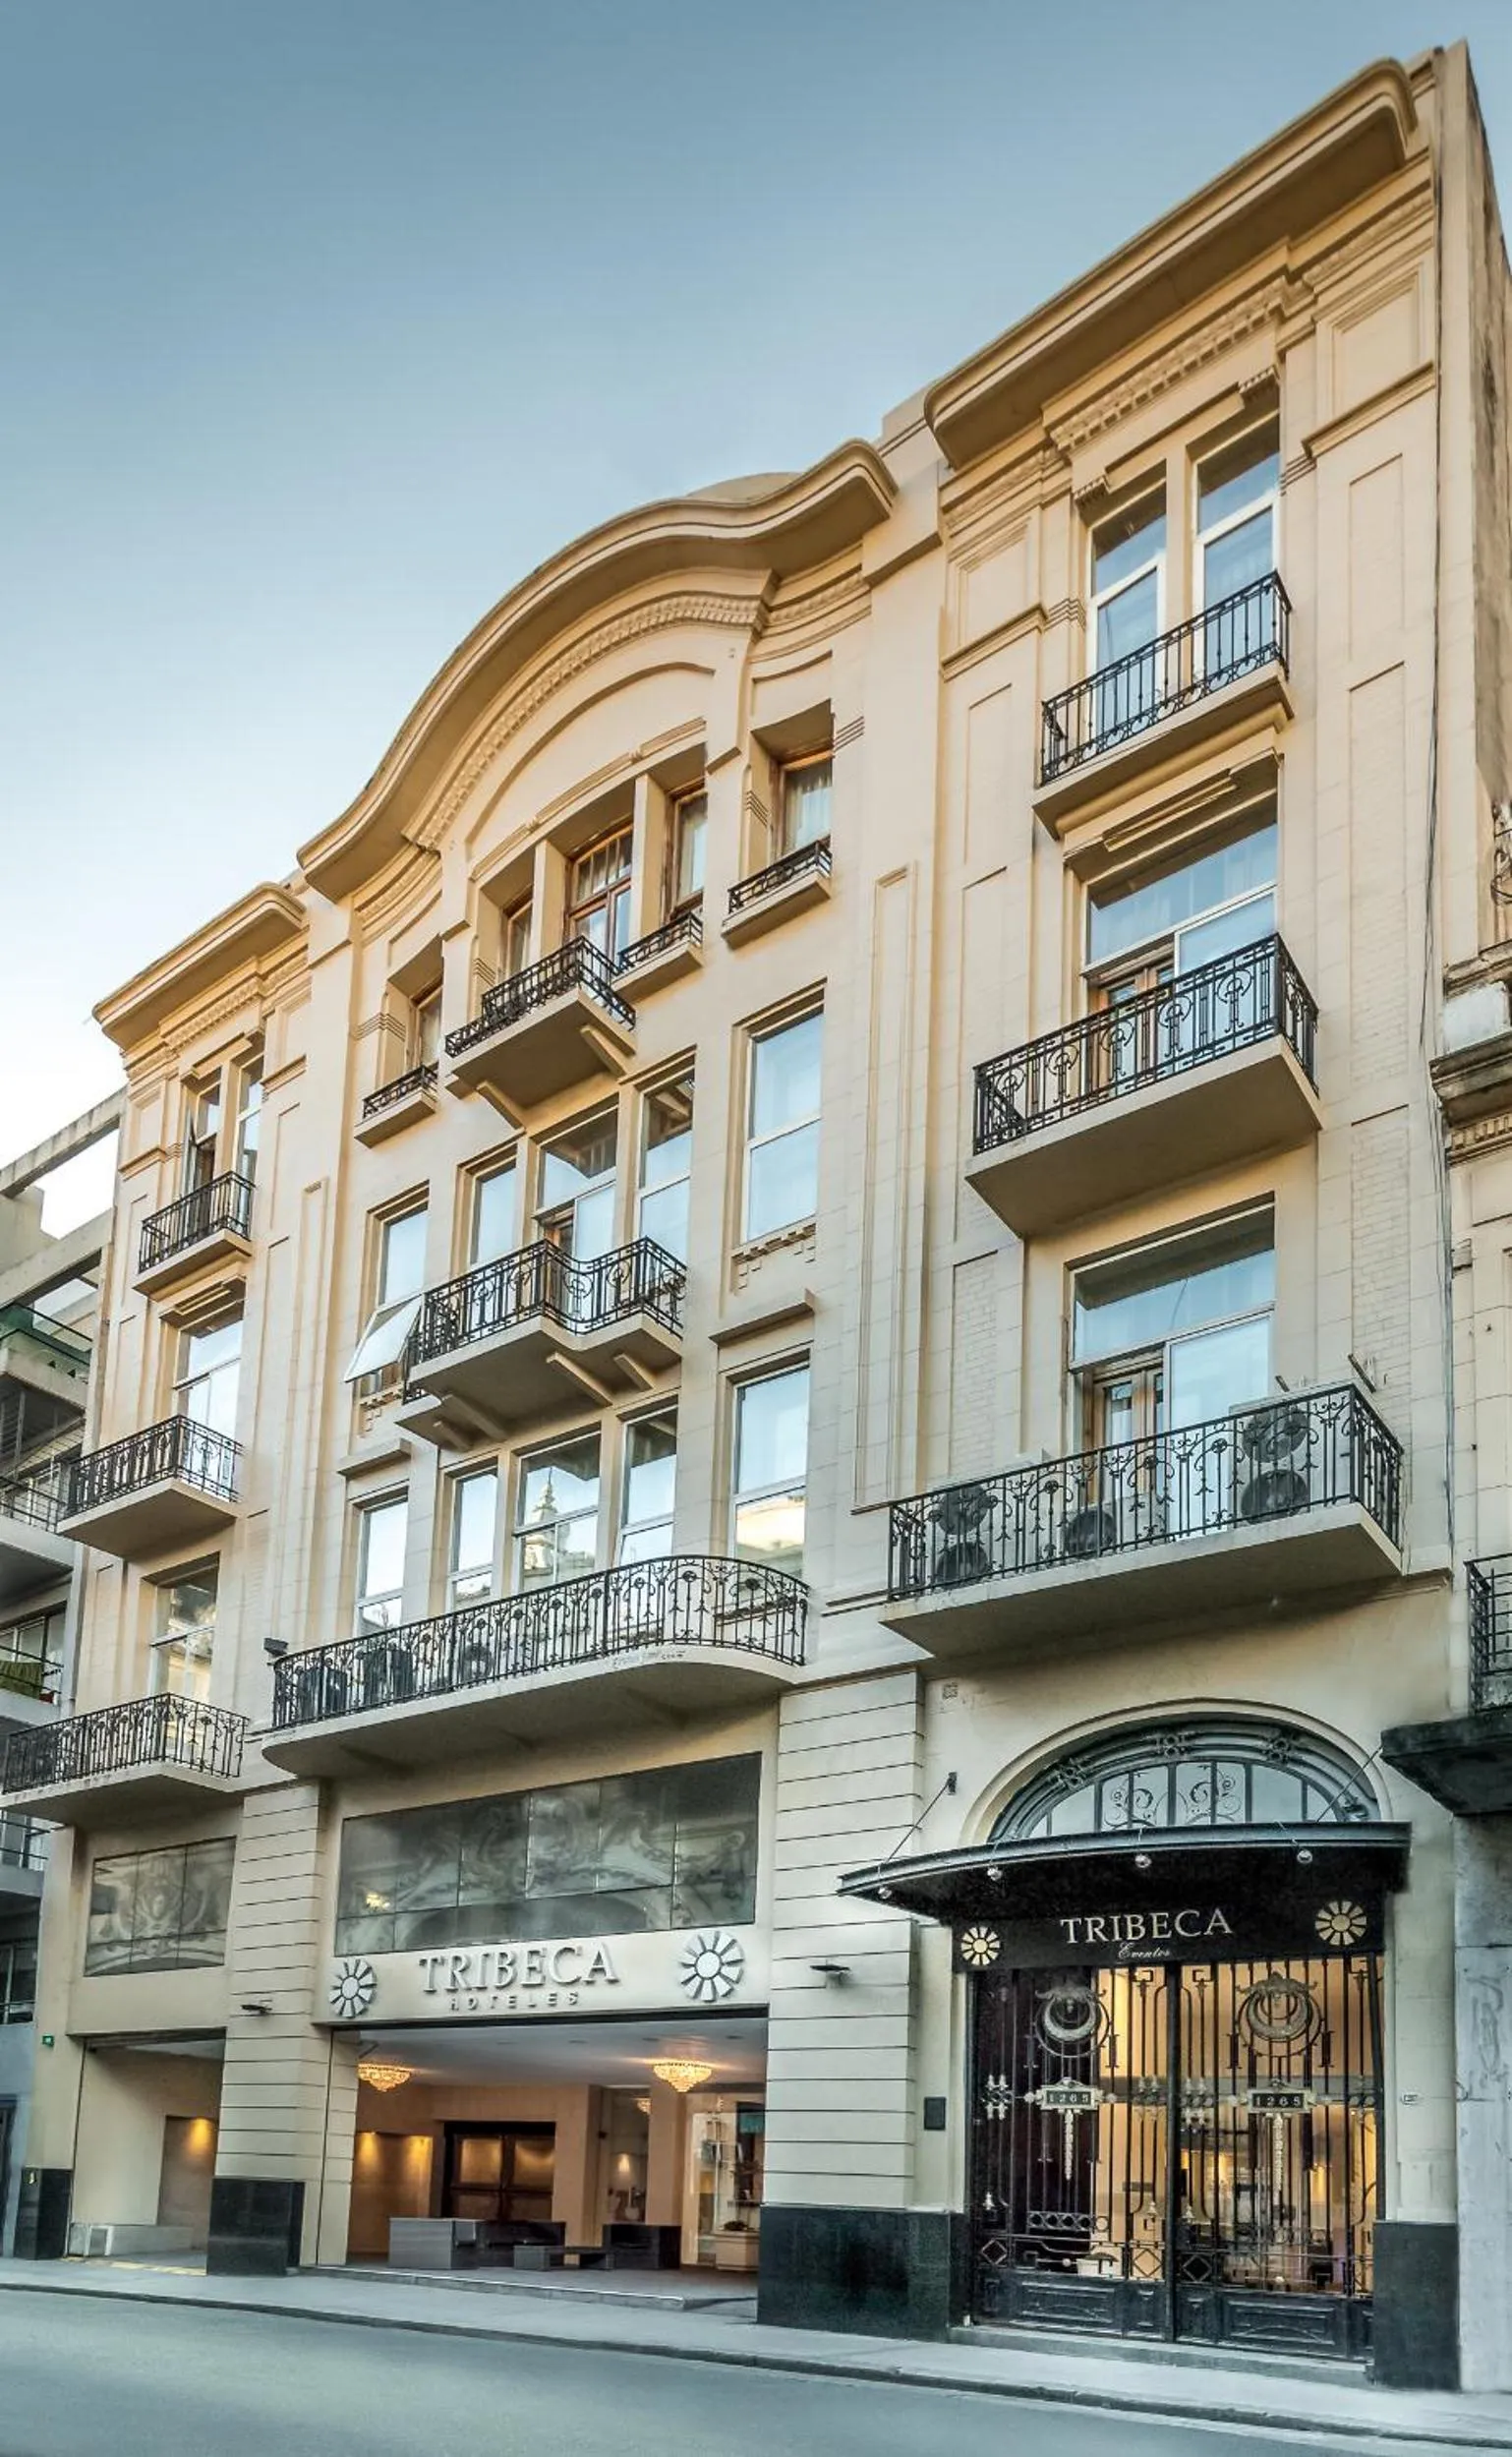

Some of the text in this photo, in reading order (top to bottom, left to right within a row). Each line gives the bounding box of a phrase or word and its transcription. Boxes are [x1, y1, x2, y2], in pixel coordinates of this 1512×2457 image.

[1060, 1907, 1234, 1944] TRIBECA
[1118, 1942, 1171, 1960] Eventos
[419, 1943, 620, 1994] TRIBECA
[450, 1992, 579, 2012] HOTELES
